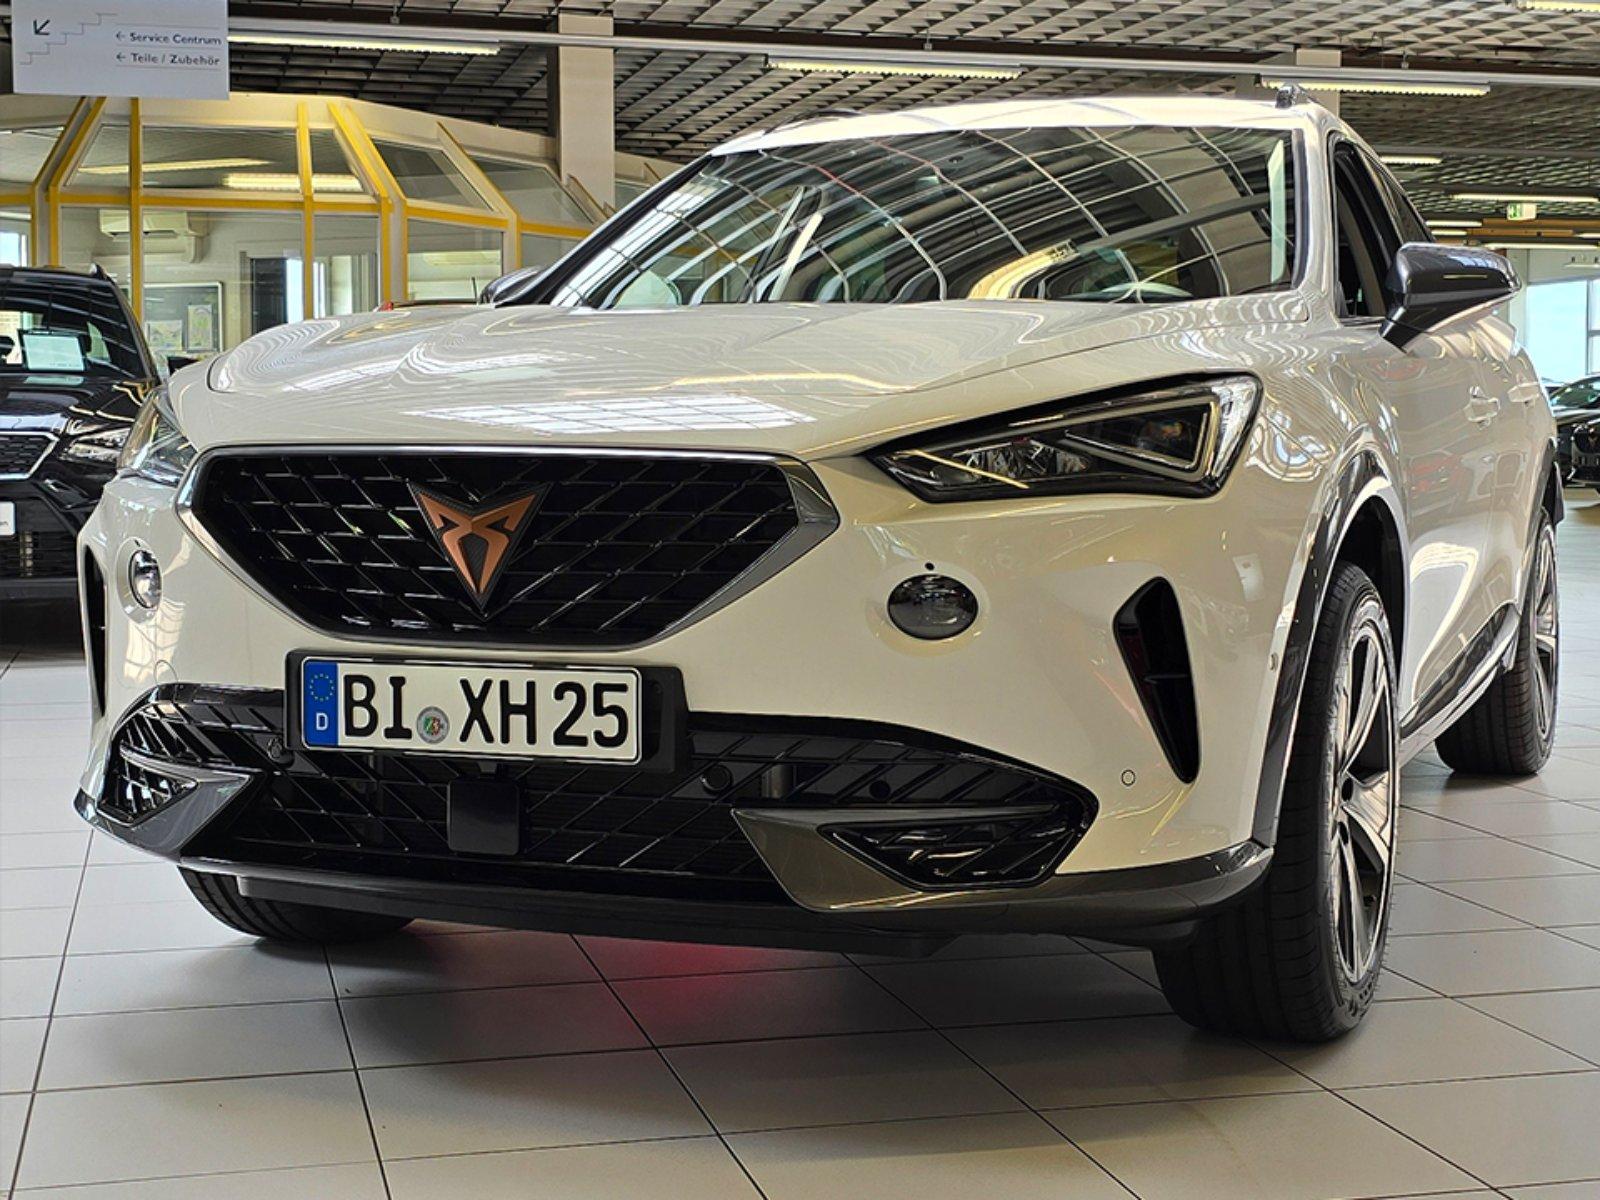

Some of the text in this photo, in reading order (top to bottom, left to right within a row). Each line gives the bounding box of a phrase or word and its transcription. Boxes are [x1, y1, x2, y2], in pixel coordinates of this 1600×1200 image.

[130, 32, 222, 45] Service Centrum
[131, 53, 159, 63] Teile
[170, 54, 220, 65] Zubehör
[343, 674, 629, 748] BI XH 25
[316, 712, 329, 731] D
